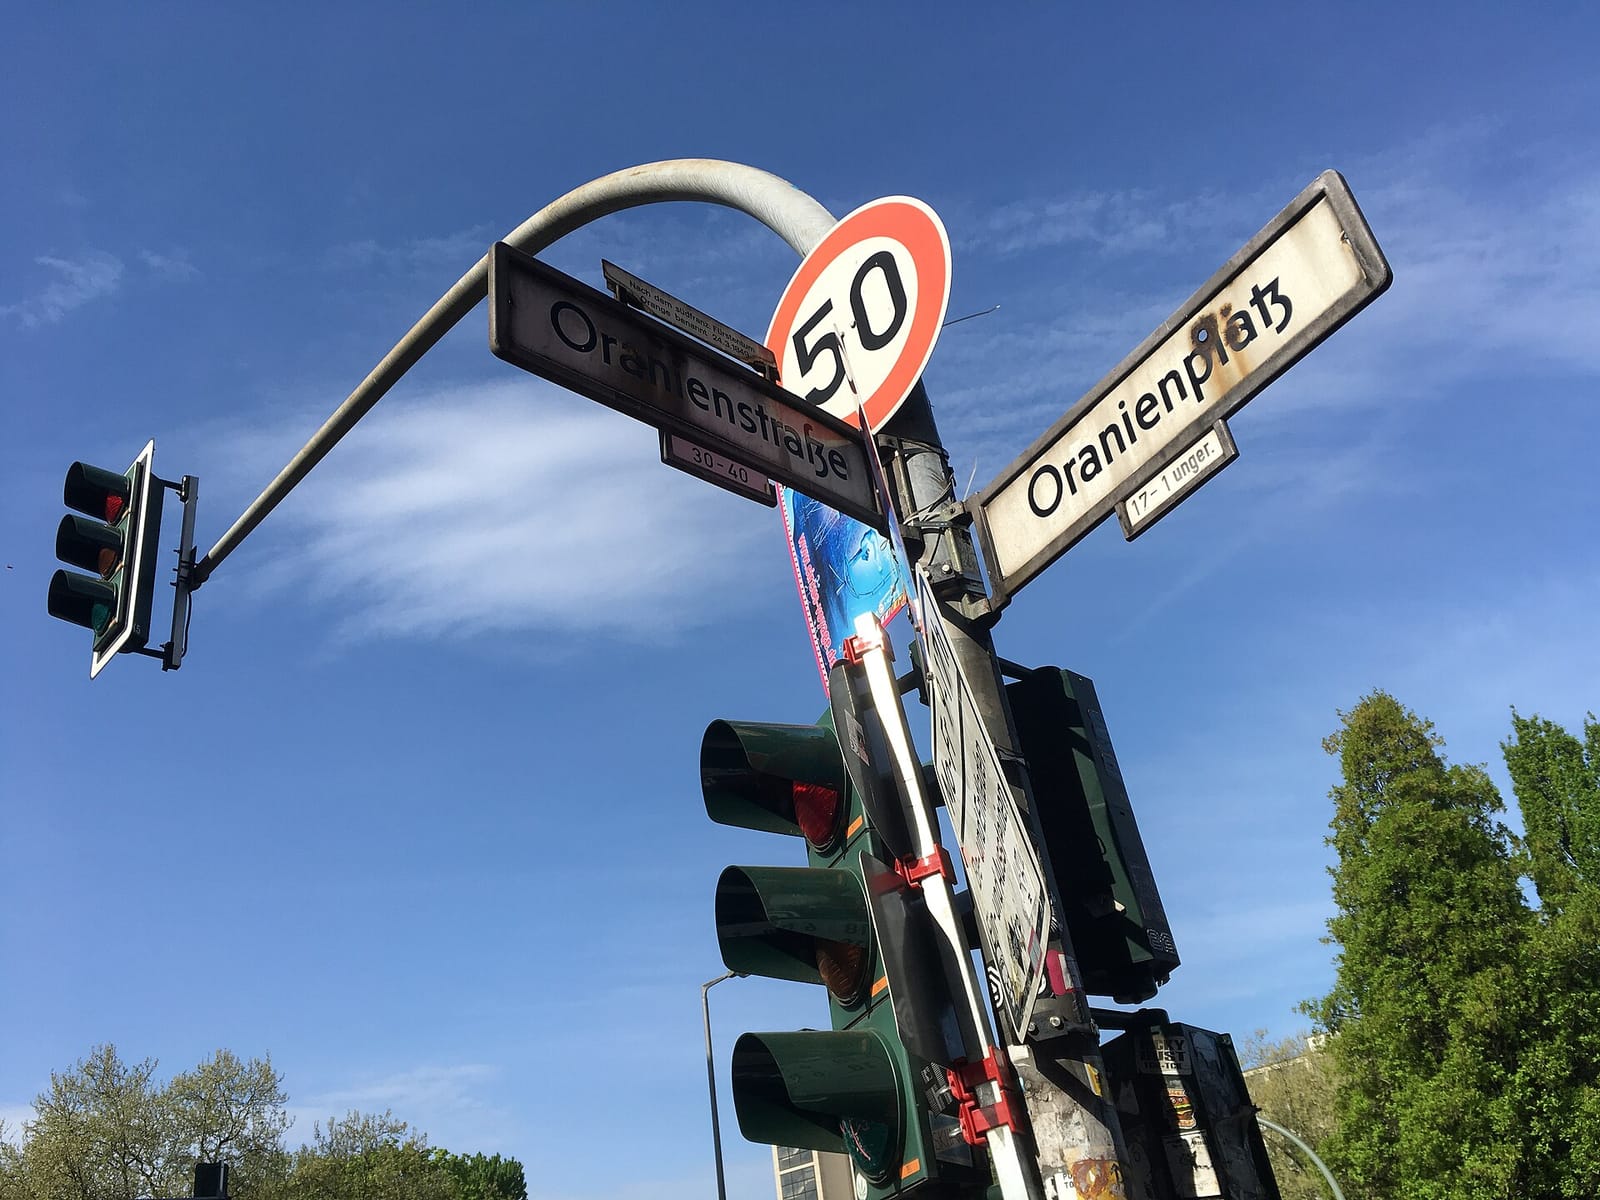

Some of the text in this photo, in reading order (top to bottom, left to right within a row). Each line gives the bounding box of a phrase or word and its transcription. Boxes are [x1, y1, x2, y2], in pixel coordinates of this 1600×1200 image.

[629, 279, 651, 298] Nach
[654, 293, 673, 308] dem
[640, 295, 671, 317] Orange
[792, 251, 907, 405] 50
[550, 300, 849, 481] Oranienstraße
[1027, 276, 1293, 518] Oranienplatz
[1172, 442, 1216, 482] unger.
